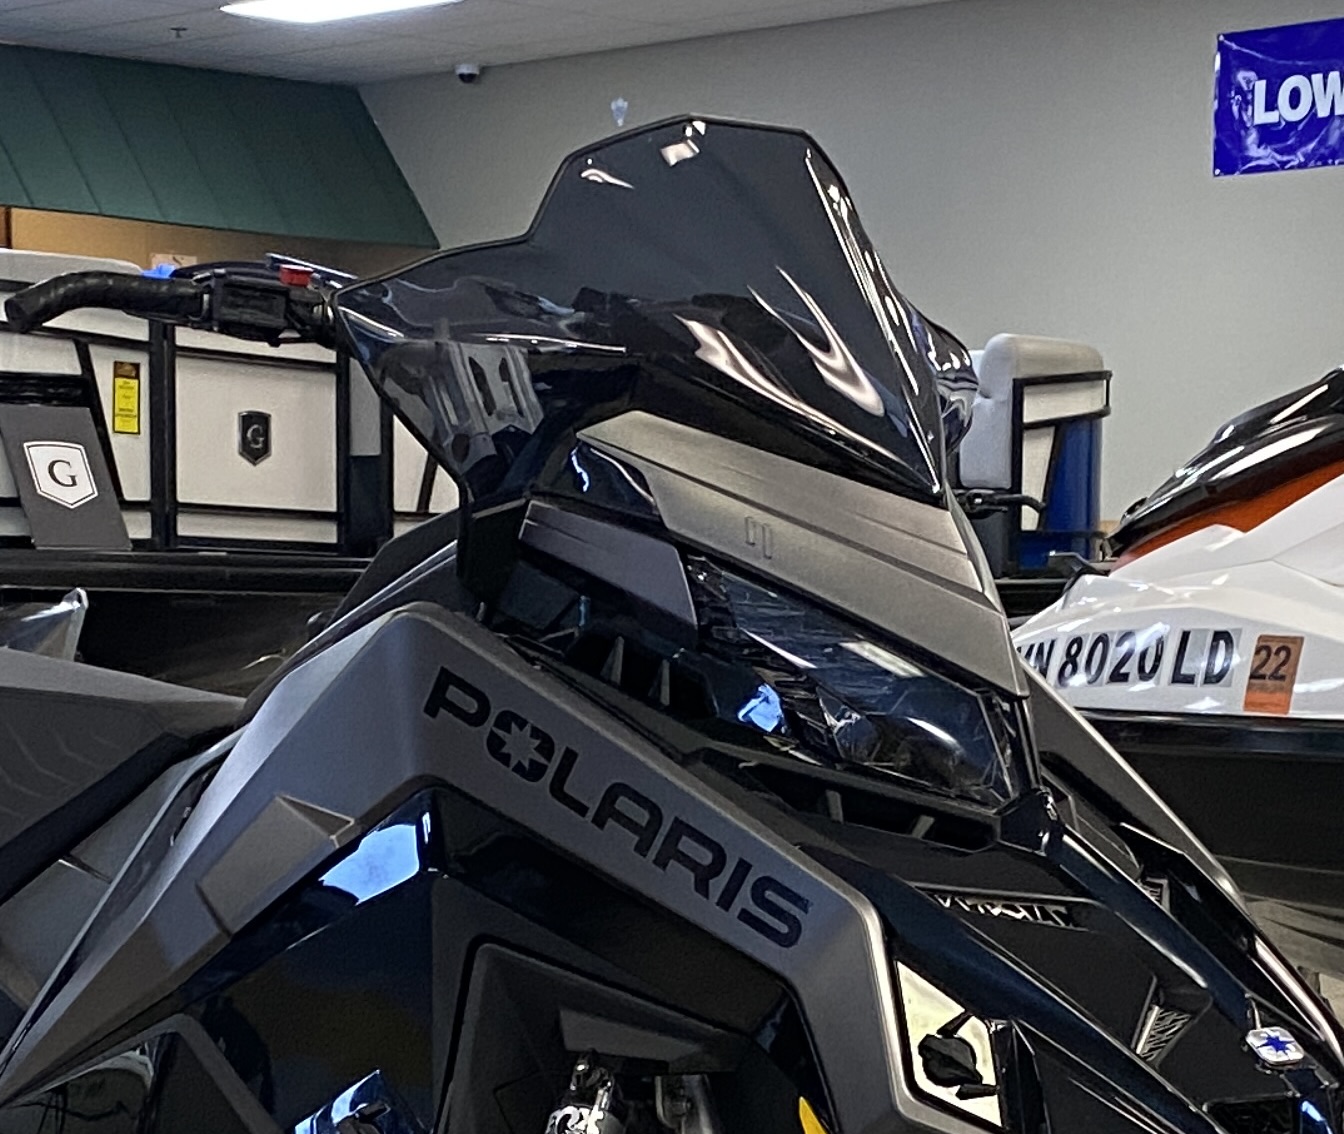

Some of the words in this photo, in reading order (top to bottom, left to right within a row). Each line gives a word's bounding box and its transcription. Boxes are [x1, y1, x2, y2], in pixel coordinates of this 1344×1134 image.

[246, 424, 265, 449] G
[47, 459, 78, 488] G
[1057, 630, 1166, 688] 8020
[1168, 629, 1237, 685] LD
[1249, 644, 1292, 681] 22
[422, 665, 814, 949] POLARIS
